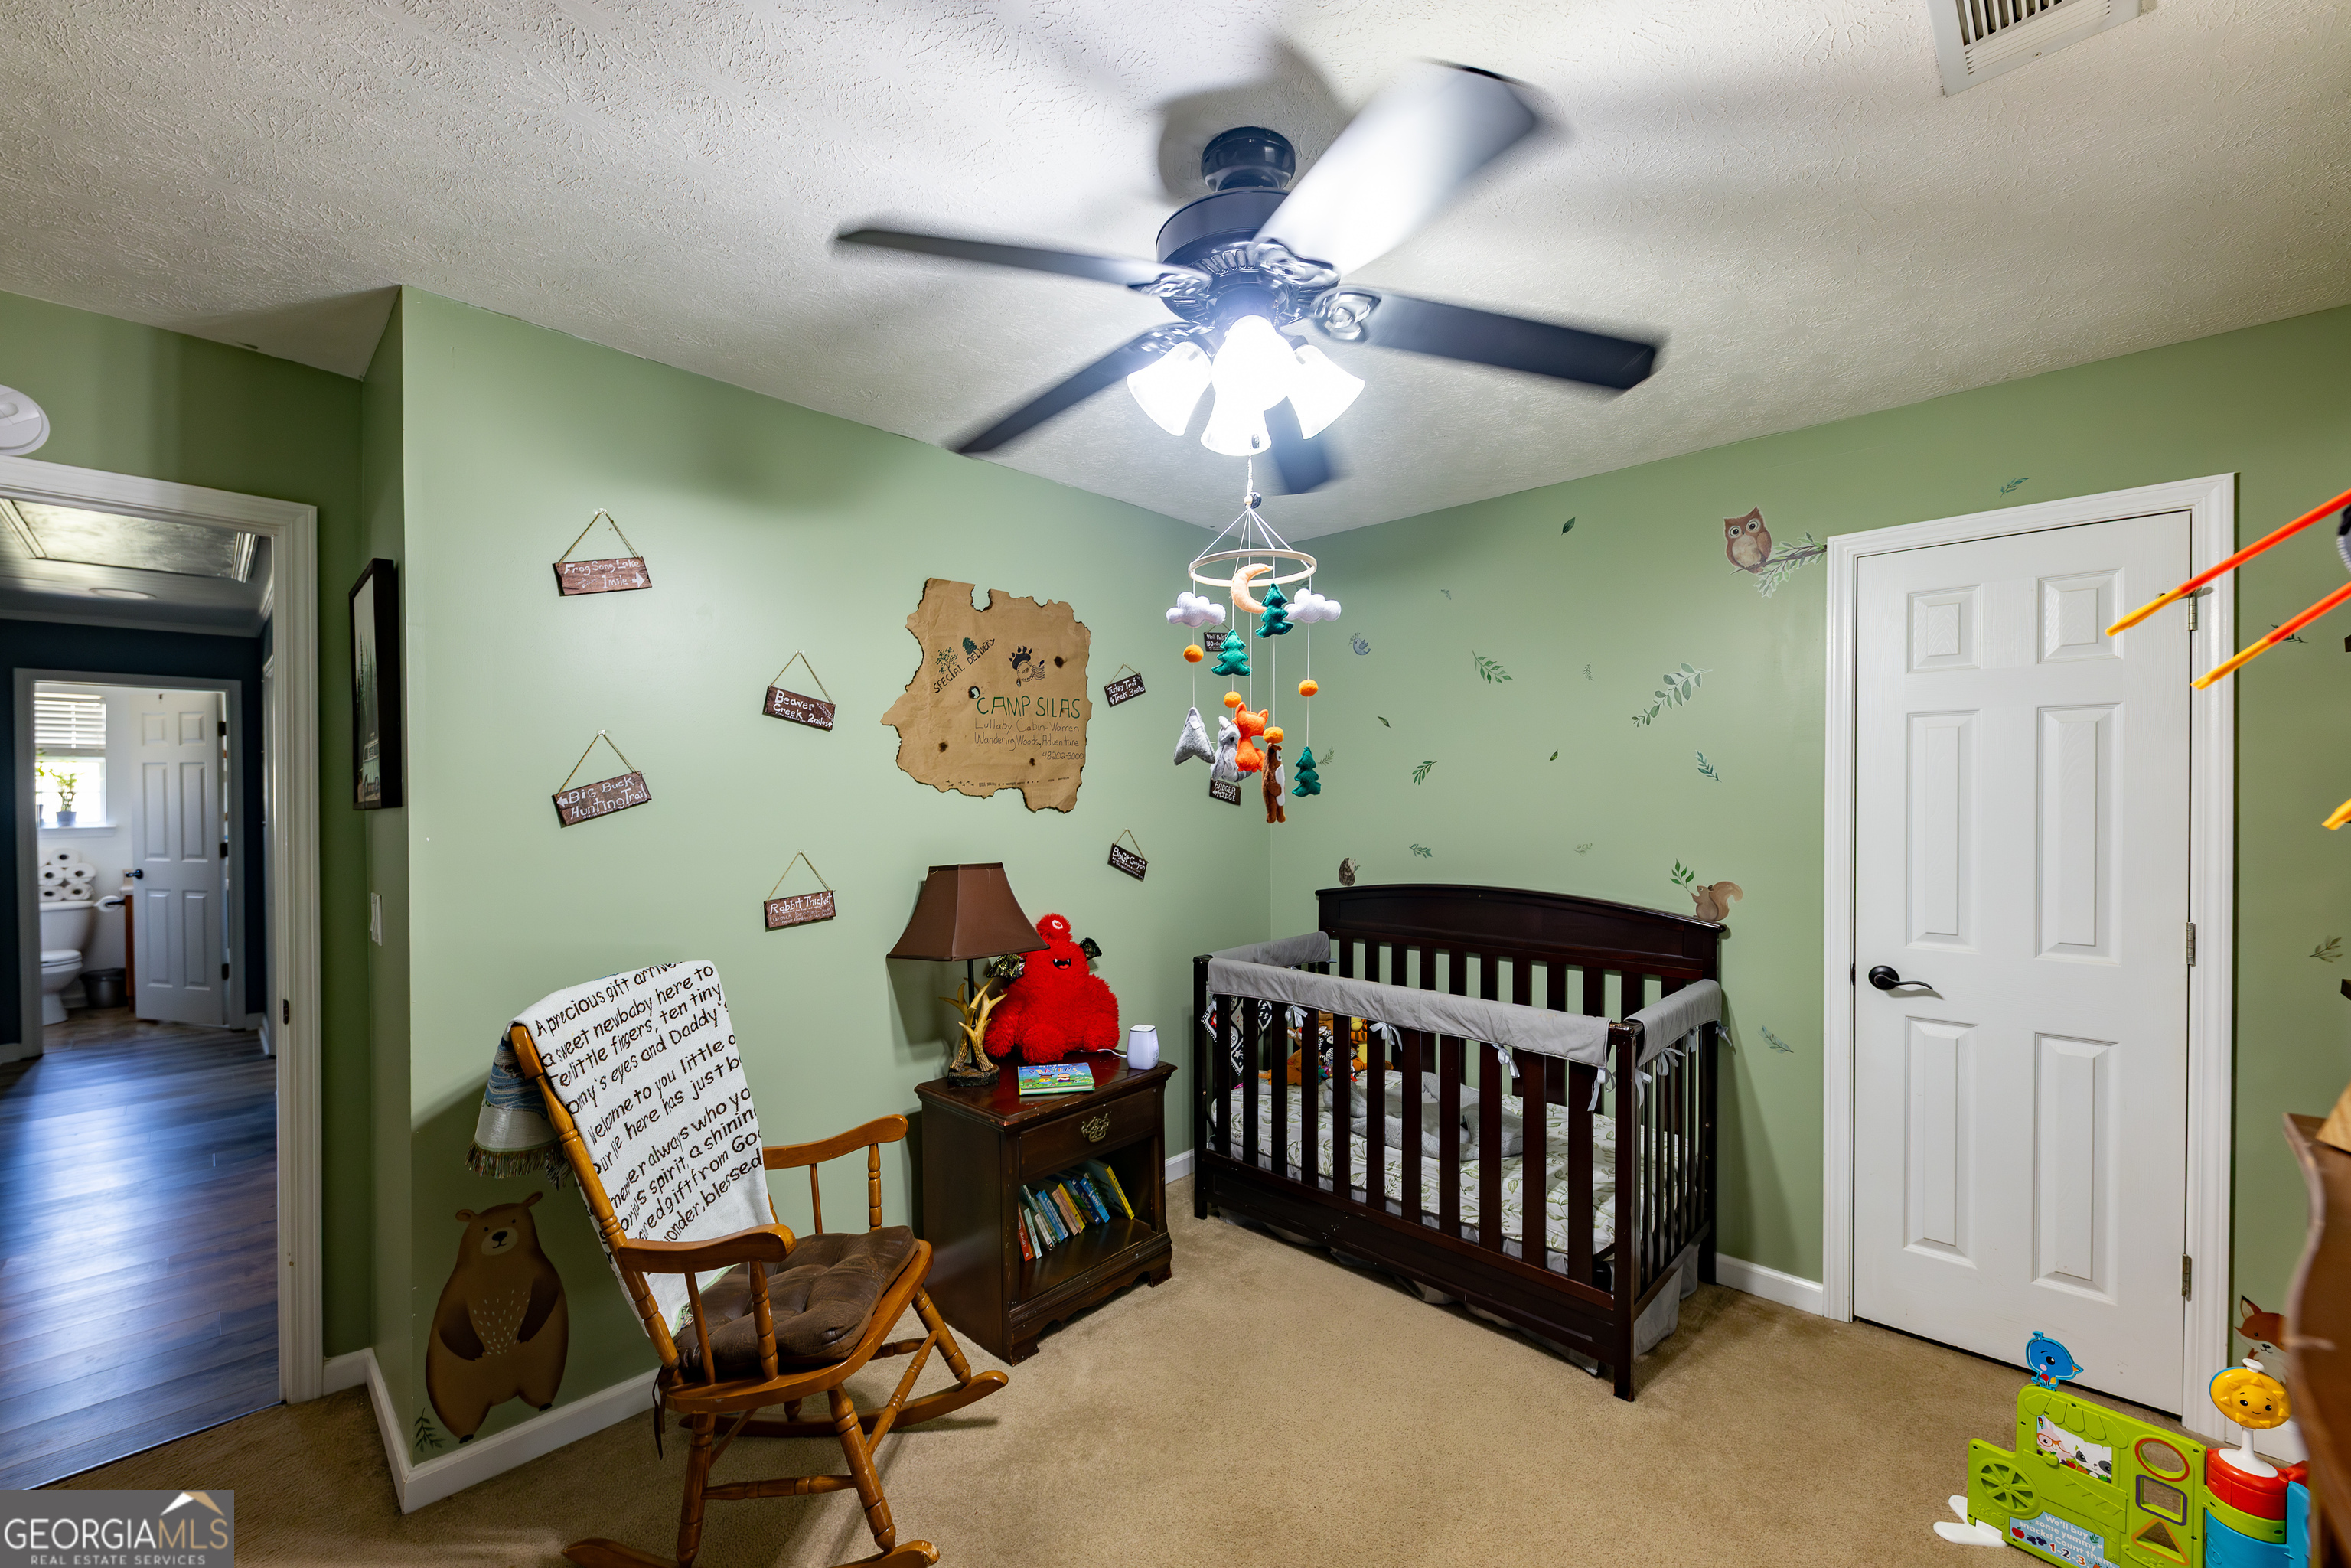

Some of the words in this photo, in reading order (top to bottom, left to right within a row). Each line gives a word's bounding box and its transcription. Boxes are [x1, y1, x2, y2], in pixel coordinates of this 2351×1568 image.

[564, 563, 591, 576] Frog
[591, 560, 615, 574] Song
[616, 559, 641, 569] Lake
[602, 575, 608, 589] 1
[608, 575, 629, 586] mile
[967, 638, 995, 665] DELIVERY
[775, 689, 815, 711] Beaver
[1107, 684, 1123, 695] Turkey
[1129, 688, 1134, 696] 3
[773, 703, 803, 720] Creek
[807, 713, 814, 723] 2
[977, 696, 1031, 717] CAMP
[1035, 697, 1081, 719] SILAS
[975, 718, 1012, 735] Lullaby
[974, 732, 1016, 751] Wandering
[1042, 733, 1080, 747] Adventure
[602, 777, 634, 793] Buck
[1214, 781, 1236, 796] BADGER
[571, 797, 625, 820] Hunting
[621, 784, 647, 804] Trail
[770, 898, 804, 915] Rabbit
[804, 892, 832, 907] Thicket
[536, 1020, 547, 1037] A
[546, 991, 605, 1037] precious
[606, 978, 630, 1002] gift
[660, 1002, 688, 1024] ten
[690, 983, 722, 1006] tiny
[542, 1052, 557, 1068] a
[556, 1029, 589, 1062] sweet
[655, 977, 693, 1005] here
[694, 966, 713, 981] to
[611, 1055, 638, 1084] eyes
[641, 1034, 667, 1061] and
[588, 1098, 634, 1146] Welcome
[634, 1086, 652, 1104] to
[654, 1070, 677, 1099] you
[680, 1041, 725, 1074] little
[624, 1109, 660, 1141] here
[662, 1090, 684, 1116] has
[690, 1064, 724, 1100] just
[648, 1126, 689, 1166] always
[691, 1103, 727, 1132] who
[690, 1146, 703, 1159] a
[665, 1179, 692, 1214] gift
[691, 1150, 729, 1186] from
[700, 1147, 762, 1207] blessed
[2019, 1521, 2053, 1540] snacks!
[2055, 1537, 2084, 1554] Count
[2035, 1519, 2059, 1534] some
[2062, 1531, 2097, 1552] yummy
[2044, 1514, 2069, 1531] We'll
[2071, 1525, 2089, 1540] buy
